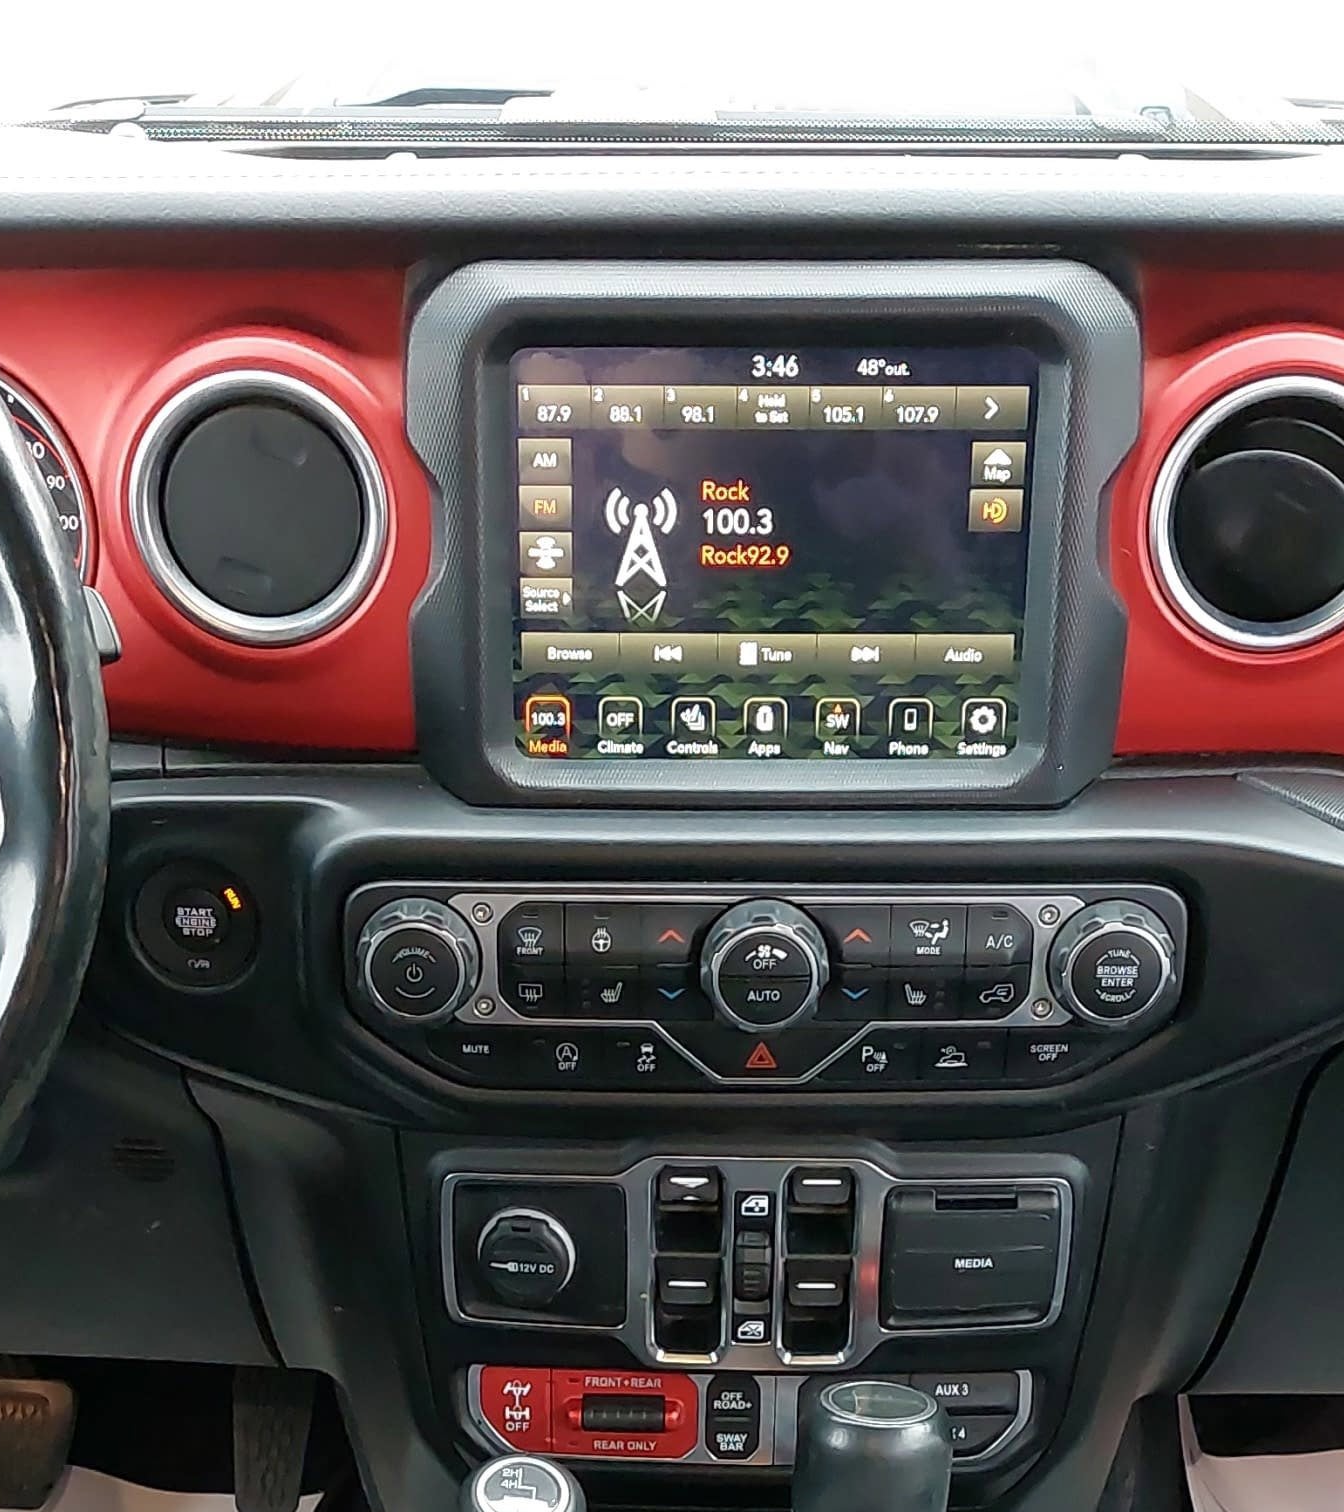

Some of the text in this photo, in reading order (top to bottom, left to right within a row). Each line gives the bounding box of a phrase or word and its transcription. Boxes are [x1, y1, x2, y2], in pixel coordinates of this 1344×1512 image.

[752, 355, 799, 378] 3:46
[521, 387, 530, 401] 1
[593, 388, 604, 401] 2
[666, 388, 676, 402] 3
[738, 388, 749, 402] 4
[811, 388, 822, 402] 5
[884, 388, 894, 402] 6
[537, 405, 572, 422] 87.9
[609, 405, 642, 423] 88.1
[681, 405, 715, 423] 98.1
[823, 406, 864, 423] 105.1
[896, 406, 939, 423] 107.9
[533, 453, 557, 468] AM
[984, 466, 1011, 482] Map
[47, 475, 65, 490] 90
[702, 480, 749, 501] Rock
[534, 500, 557, 514] FM
[703, 508, 773, 534] 100.3
[701, 544, 790, 565] Rock92.9
[523, 586, 560, 599] Source
[525, 600, 559, 613] Select
[547, 646, 593, 661] Browse
[761, 647, 792, 662] Tune
[944, 647, 983, 663] Audio
[531, 712, 566, 726] 100.3
[606, 713, 635, 727] OFF
[825, 714, 850, 729] SW
[529, 740, 568, 754] Media
[597, 741, 644, 755] Climate
[666, 741, 719, 755] Controls
[748, 741, 781, 756] Apps
[823, 741, 850, 756] Nav
[888, 741, 930, 756] Phone
[957, 741, 1007, 757] Settings
[223, 887, 242, 909] RUN
[177, 907, 213, 917] START
[175, 917, 217, 928] ENGINE
[182, 928, 214, 937] STOP
[985, 934, 1014, 950] A/C
[516, 946, 544, 956] FRONT
[916, 946, 941, 955] MODE
[1108, 949, 1131, 959] TUNE
[753, 959, 777, 970] OFF
[1096, 965, 1138, 975] BROWSE
[1101, 977, 1134, 987] ENTER
[747, 990, 781, 1001] AUTO
[462, 1044, 490, 1054] MUTE
[1030, 1043, 1069, 1053] SCREEN
[1038, 1052, 1057, 1062] OFF
[558, 1061, 577, 1071] OFF
[637, 1062, 656, 1072] OFF
[866, 1062, 886, 1072] OFF
[519, 1263, 555, 1274] 12V DC
[954, 1257, 994, 1268] MEDIA
[721, 1392, 743, 1401] OFF
[935, 1384, 970, 1396] AUX 3
[505, 1421, 530, 1432] OFF
[716, 1433, 748, 1444] SWAY
[593, 1440, 657, 1452] REAR ONLY
[719, 1442, 744, 1452] BAR
[500, 1479, 518, 1489] 4H
